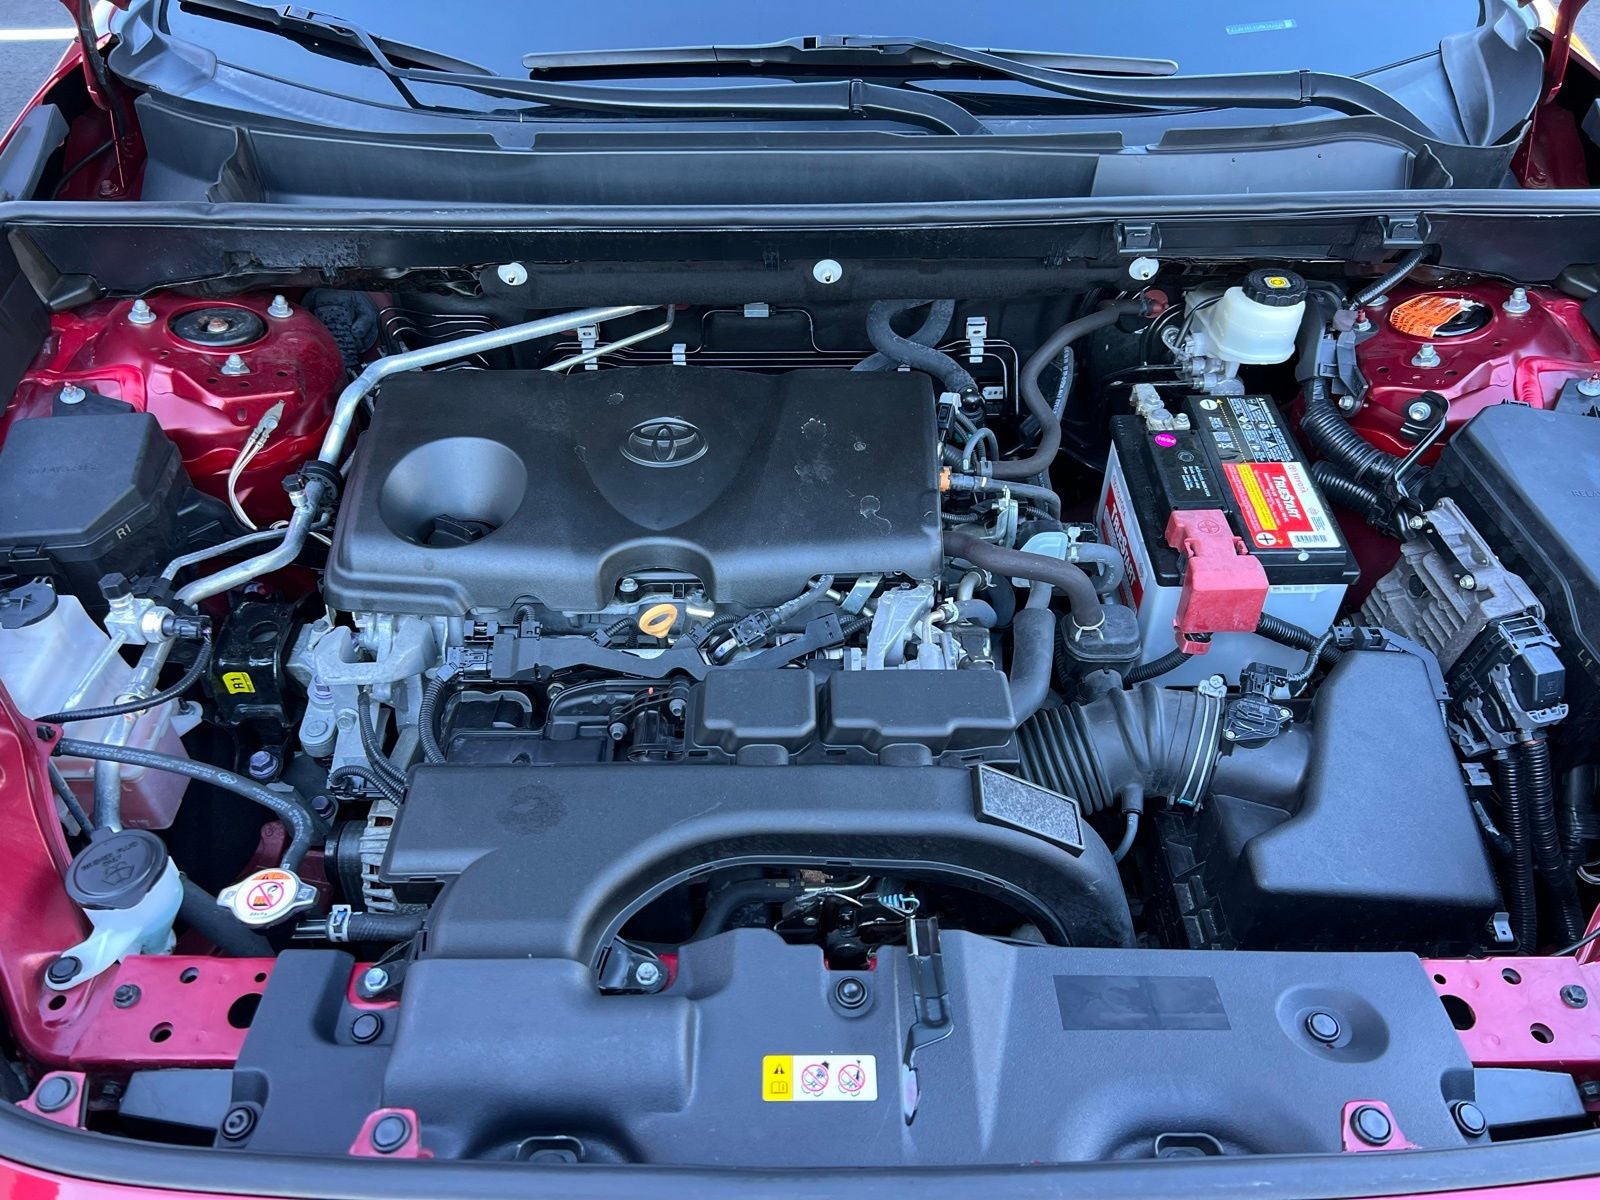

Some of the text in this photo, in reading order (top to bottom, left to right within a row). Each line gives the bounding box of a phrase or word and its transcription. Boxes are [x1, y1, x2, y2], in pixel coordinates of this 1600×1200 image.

[116, 523, 132, 540] R1
[1577, 649, 1592, 667] L1
[230, 677, 245, 689] R1
